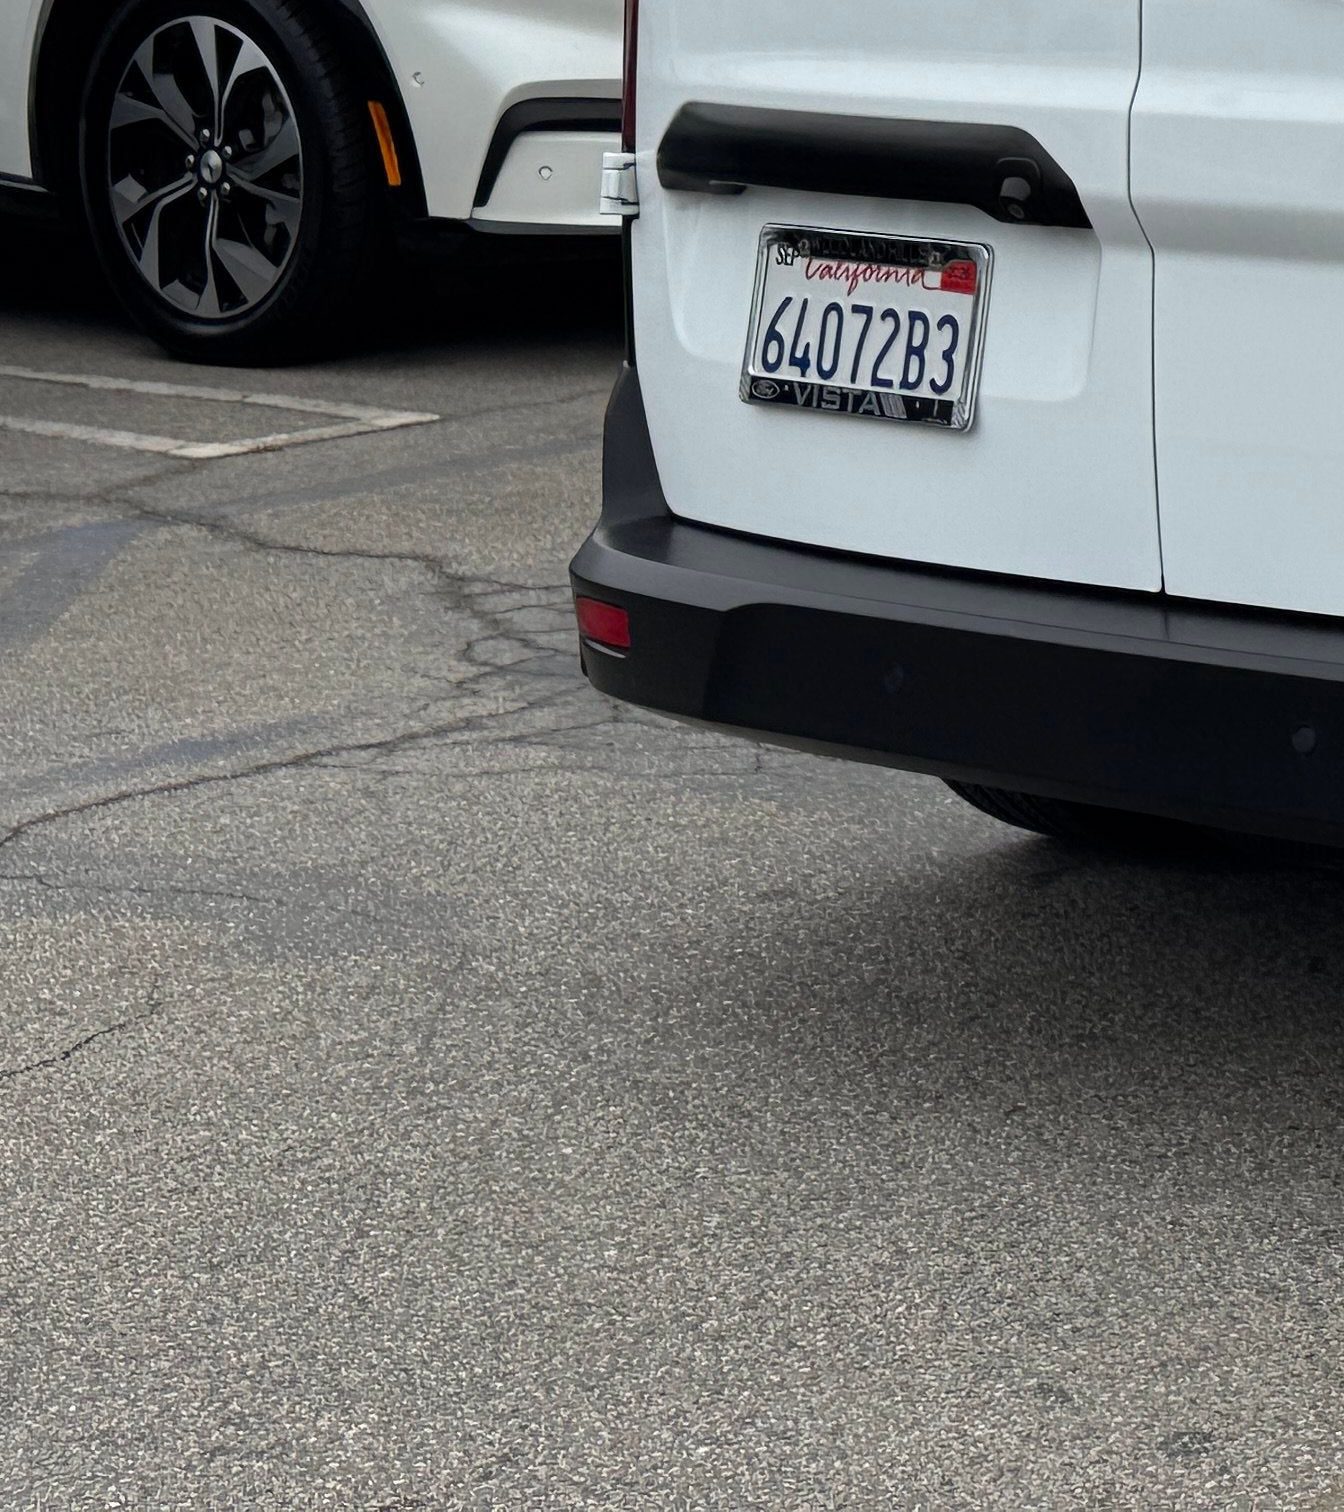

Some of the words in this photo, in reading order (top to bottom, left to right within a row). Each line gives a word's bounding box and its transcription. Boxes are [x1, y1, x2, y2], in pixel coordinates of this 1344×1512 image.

[804, 256, 930, 297] California
[761, 296, 960, 395] 64072B3
[793, 381, 882, 416] VISTA
